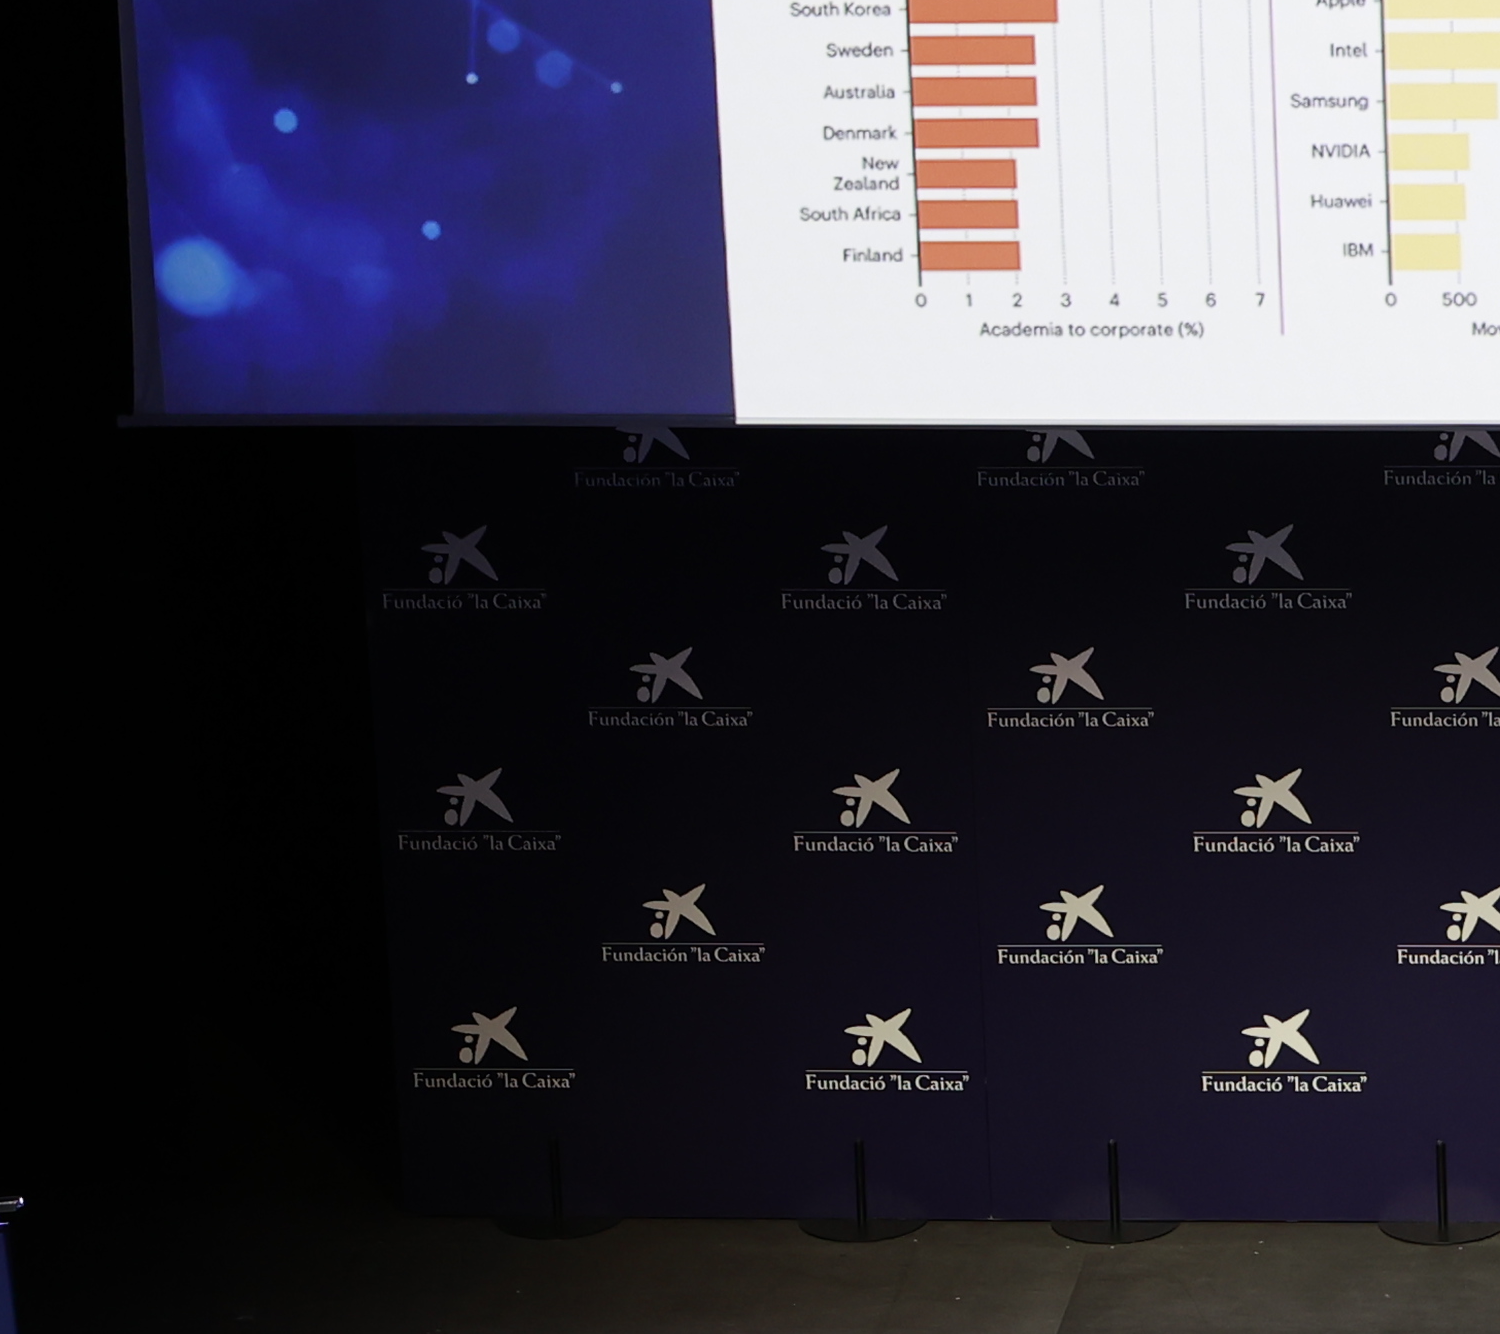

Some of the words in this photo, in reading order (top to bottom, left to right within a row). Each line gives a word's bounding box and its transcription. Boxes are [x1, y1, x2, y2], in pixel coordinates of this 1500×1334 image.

[789, 0, 840, 18] South
[843, 1, 892, 18] Korea
[826, 41, 894, 59] Sweden
[1329, 41, 1368, 59] Intel
[823, 83, 896, 101] Australia
[1290, 91, 1369, 112] Samsung
[822, 124, 897, 142] Denmark
[1311, 142, 1371, 159] NVIDIA
[861, 155, 899, 172] New
[833, 175, 900, 192] Zealand
[1310, 192, 1373, 210] Huawei
[799, 206, 849, 223] South
[853, 205, 902, 222] Africa
[842, 247, 904, 263] Finland
[1342, 242, 1374, 259] IBM
[979, 320, 1064, 338] Academia
[1067, 323, 1086, 338] to
[1089, 323, 1174, 340] corporate
[1177, 320, 1205, 340] (%)
[781, 592, 863, 610] Fundació
[793, 835, 875, 853] Fundació
[1397, 948, 1485, 965] Fundación
